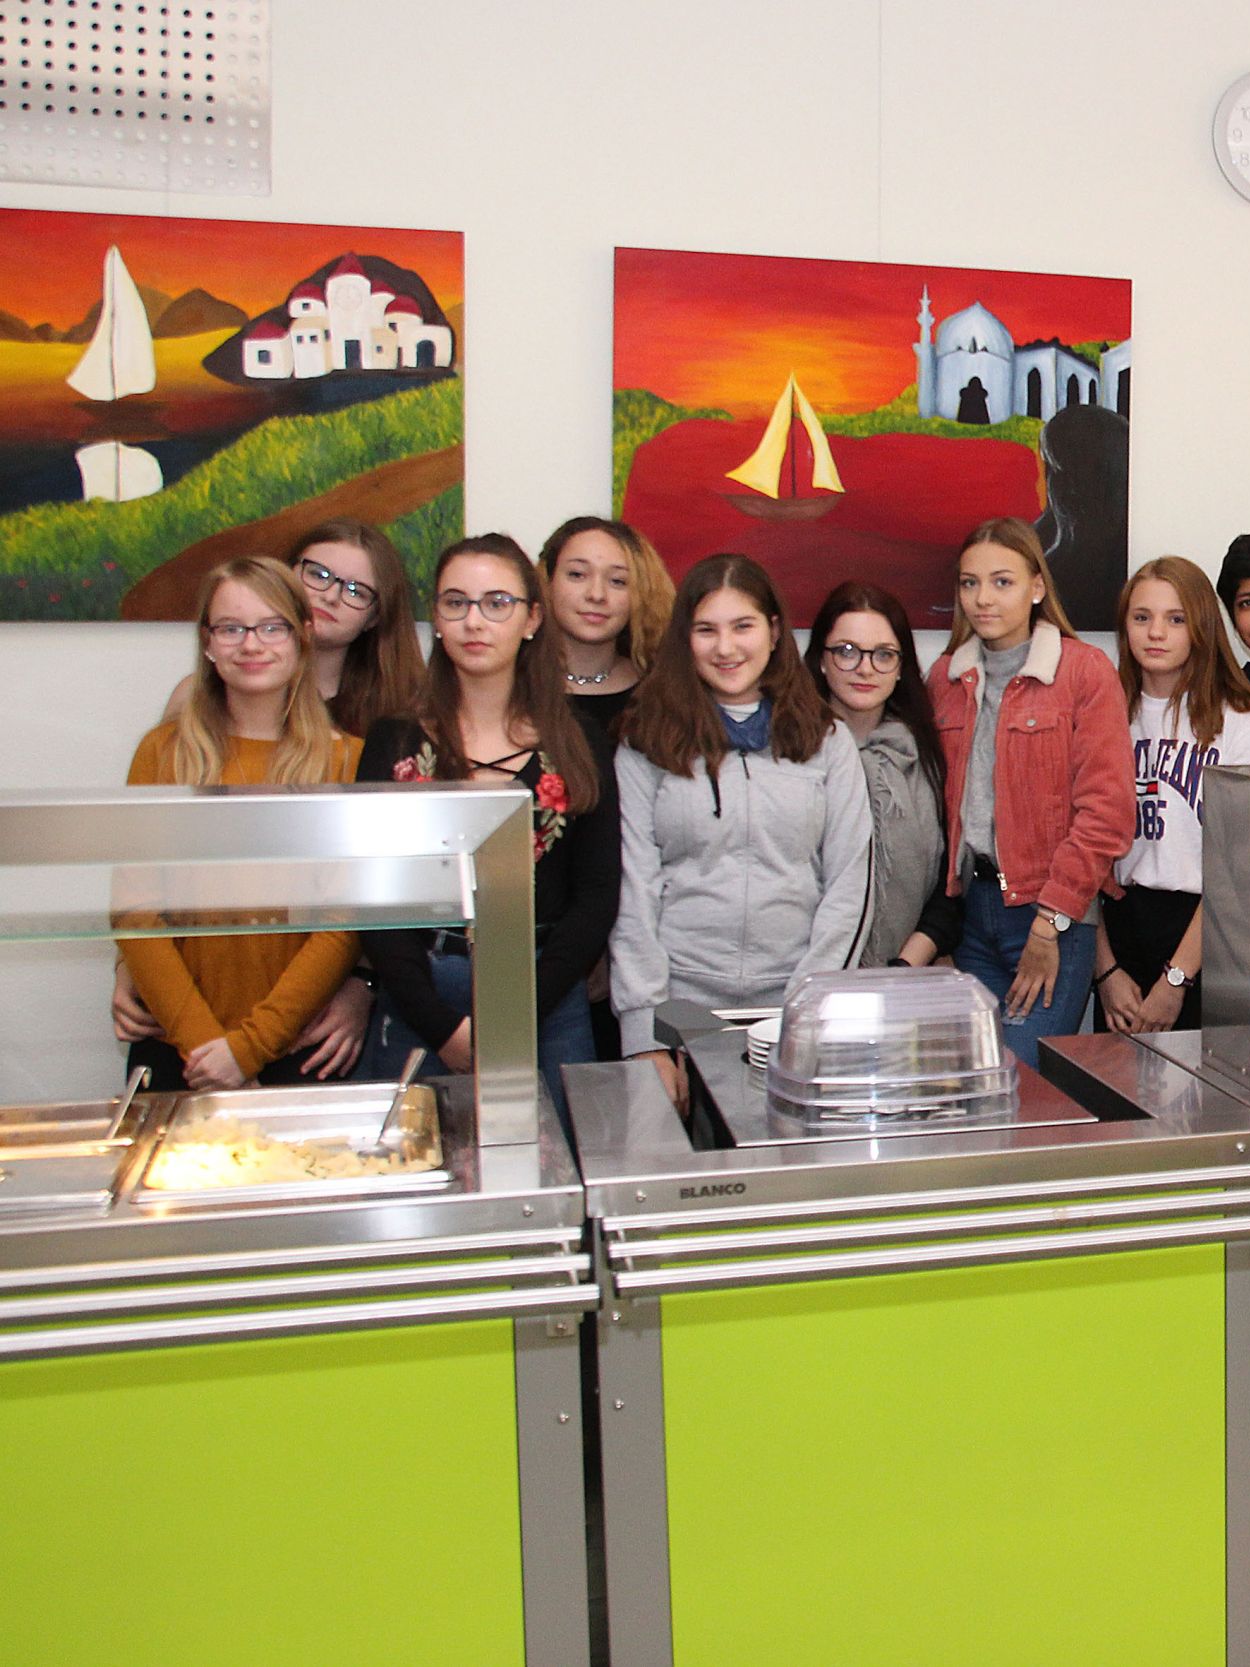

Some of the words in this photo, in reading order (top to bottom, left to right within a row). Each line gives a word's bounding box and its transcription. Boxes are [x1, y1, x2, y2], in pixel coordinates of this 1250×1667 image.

[1232, 128, 1243, 143] 9
[1240, 152, 1250, 167] 8
[680, 1182, 747, 1200] BLANCO
